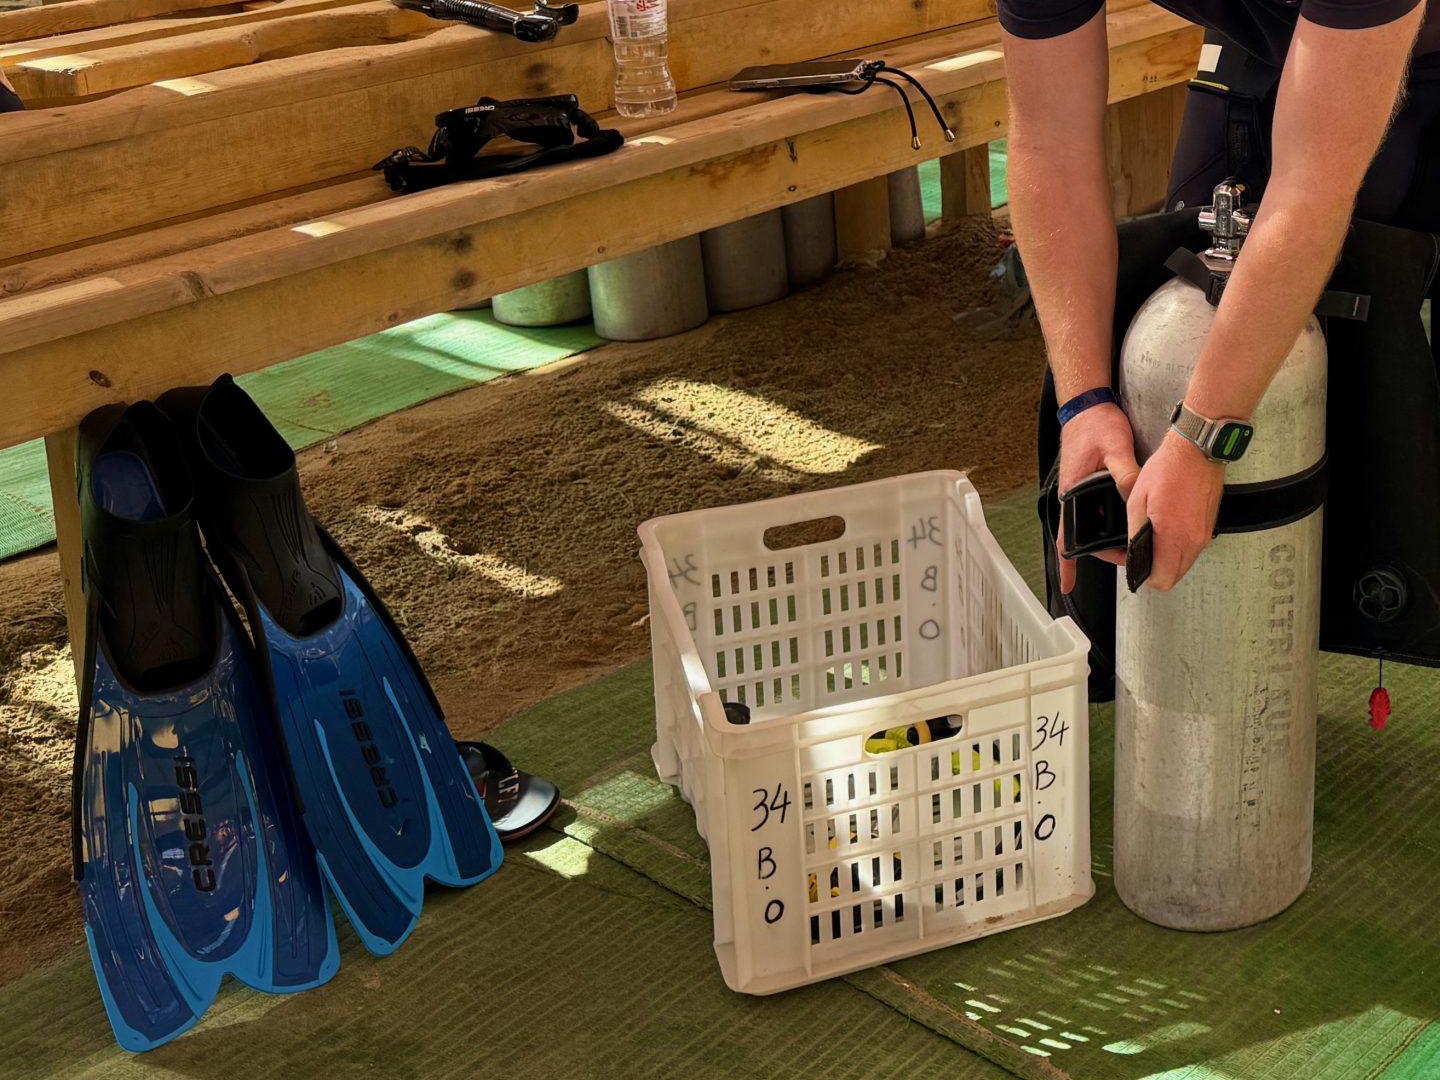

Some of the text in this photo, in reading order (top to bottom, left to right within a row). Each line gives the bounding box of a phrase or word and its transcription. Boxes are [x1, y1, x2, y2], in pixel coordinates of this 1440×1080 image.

[465, 105, 496, 114] CRESSI
[1266, 542, 1297, 674] COLTRI
[339, 688, 400, 810] CRESSI
[1031, 712, 1069, 751] 34
[173, 756, 217, 894] CRESSI
[750, 784, 792, 832] 34
